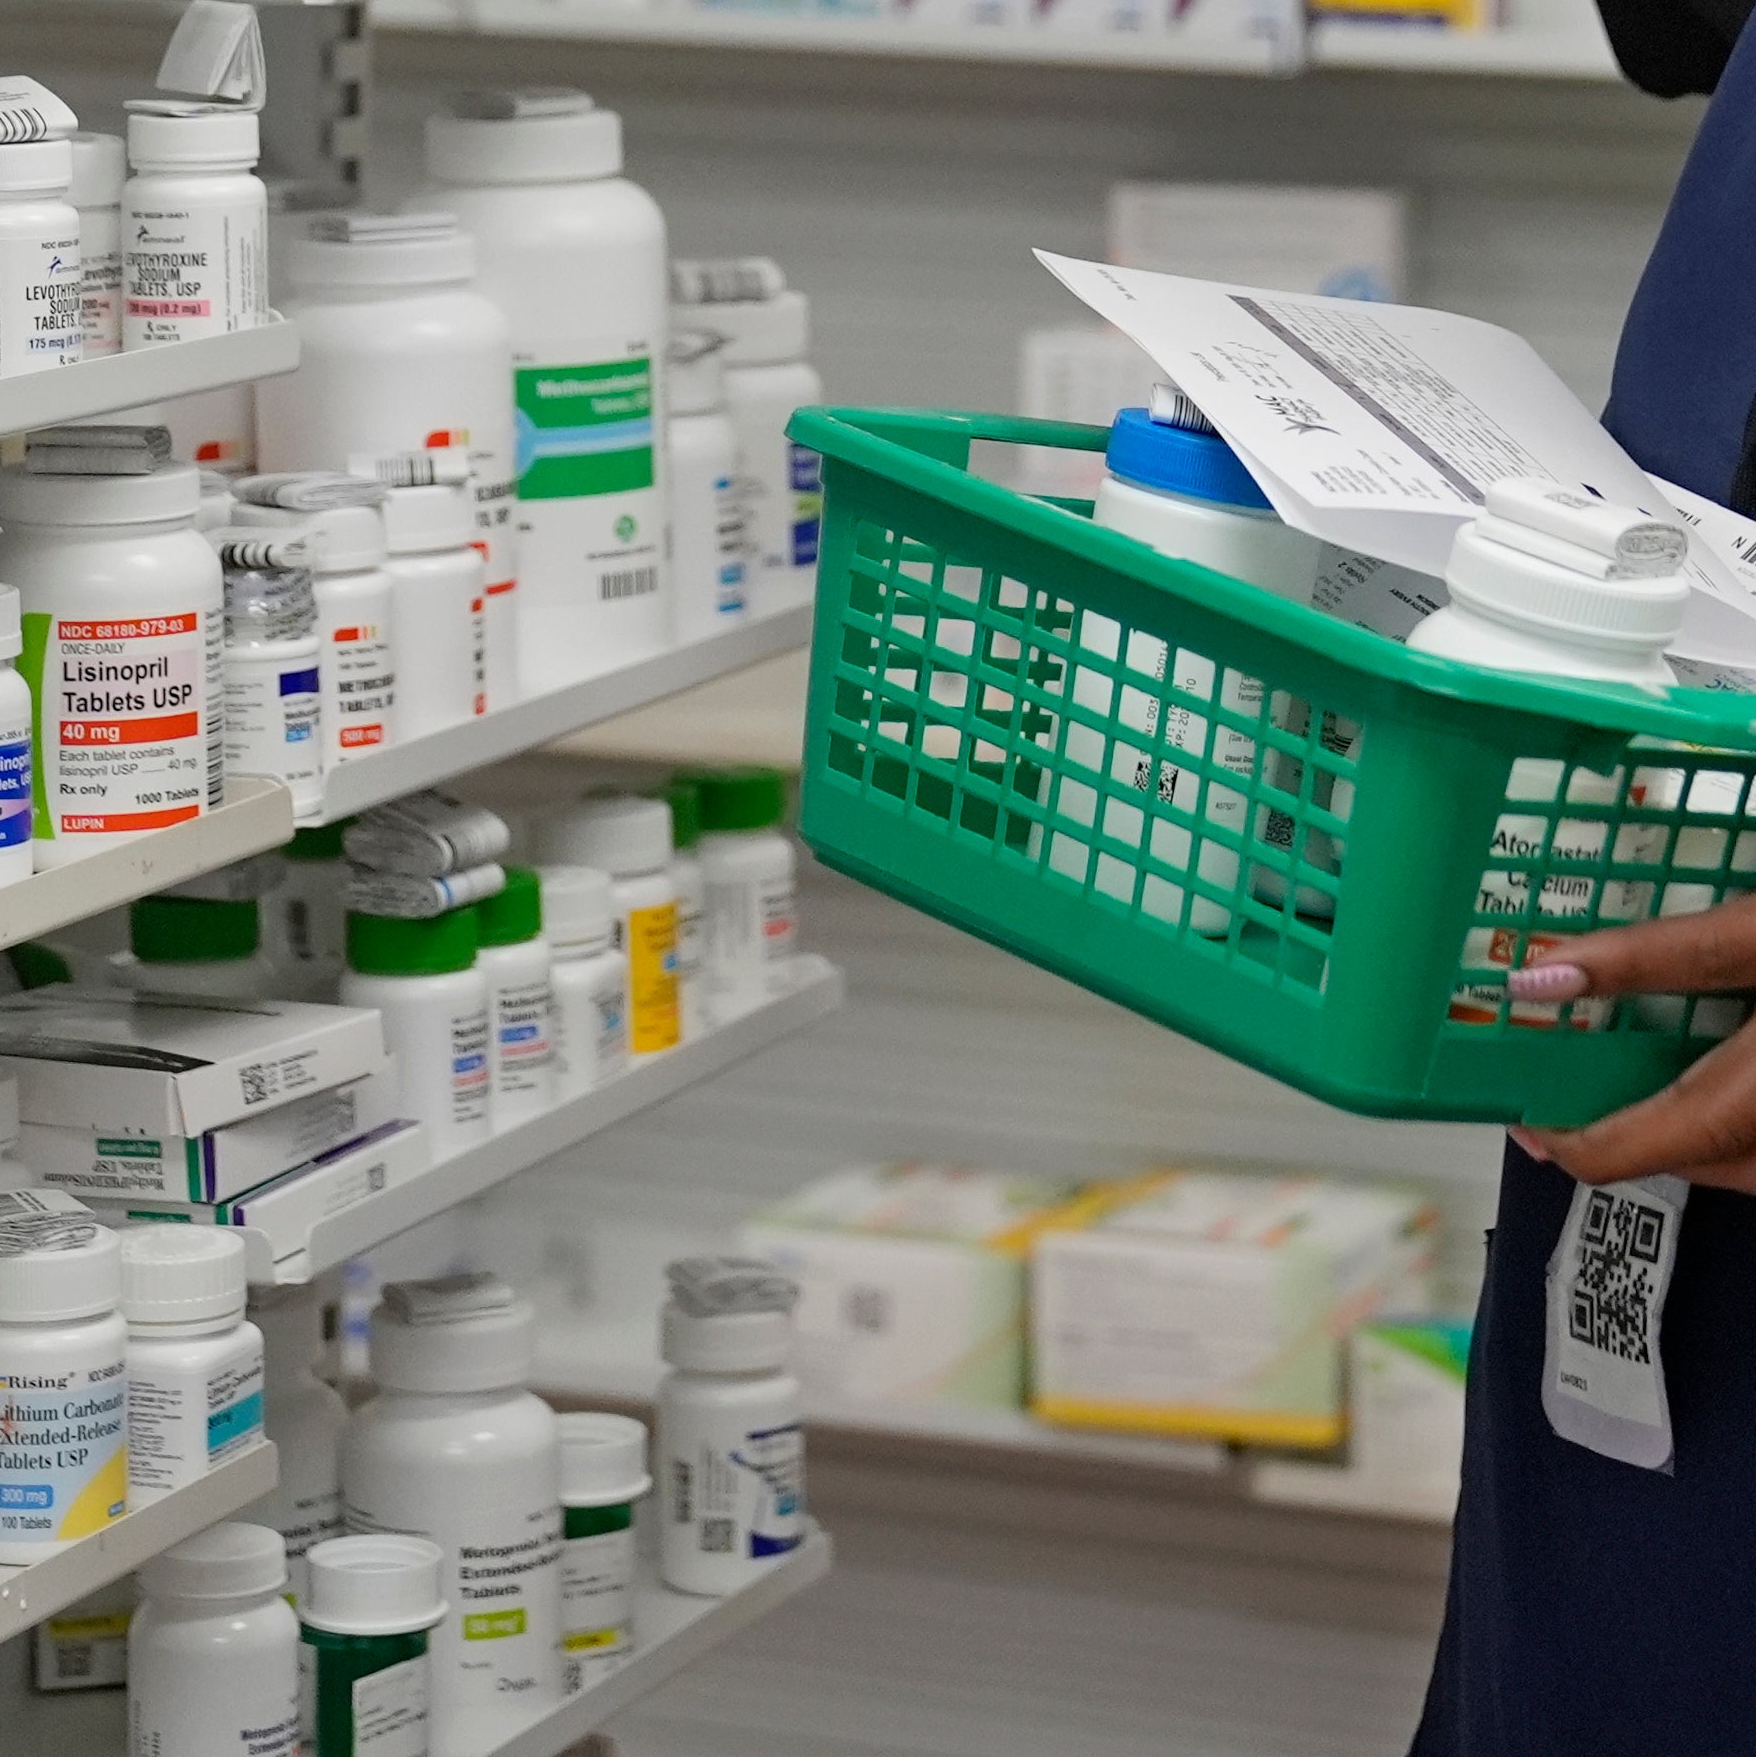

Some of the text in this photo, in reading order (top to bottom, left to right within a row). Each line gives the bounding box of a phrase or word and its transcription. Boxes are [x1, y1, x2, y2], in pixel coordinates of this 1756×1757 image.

[138, 268, 180, 282] SODIUM
[176, 283, 201, 297] USP
[159, 303, 201, 314] (0.2 mg)
[35, 314, 76, 331] TABLETS,
[29, 338, 66, 349] 175 mcg
[1732, 537, 1747, 550] N
[61, 619, 184, 638] NDC 68180-979-03
[61, 643, 124, 655] ONCE-DAILY
[63, 656, 168, 685] Lisinopril
[63, 683, 192, 713] Tablets USP
[63, 724, 120, 742] 40 mg
[59, 746, 174, 762] Each tablet contains
[59, 759, 197, 778] lisinopril USP 40 mg
[60, 783, 107, 796] Rx only
[134, 787, 199, 804] 1000 Tablets
[63, 818, 104, 830] LUPIN
[9, 1374, 68, 1390] Rising
[57, 1448, 89, 1468] USP
[1, 1489, 47, 1504] 300 mg
[1, 1516, 53, 1530] 100 Tablets
